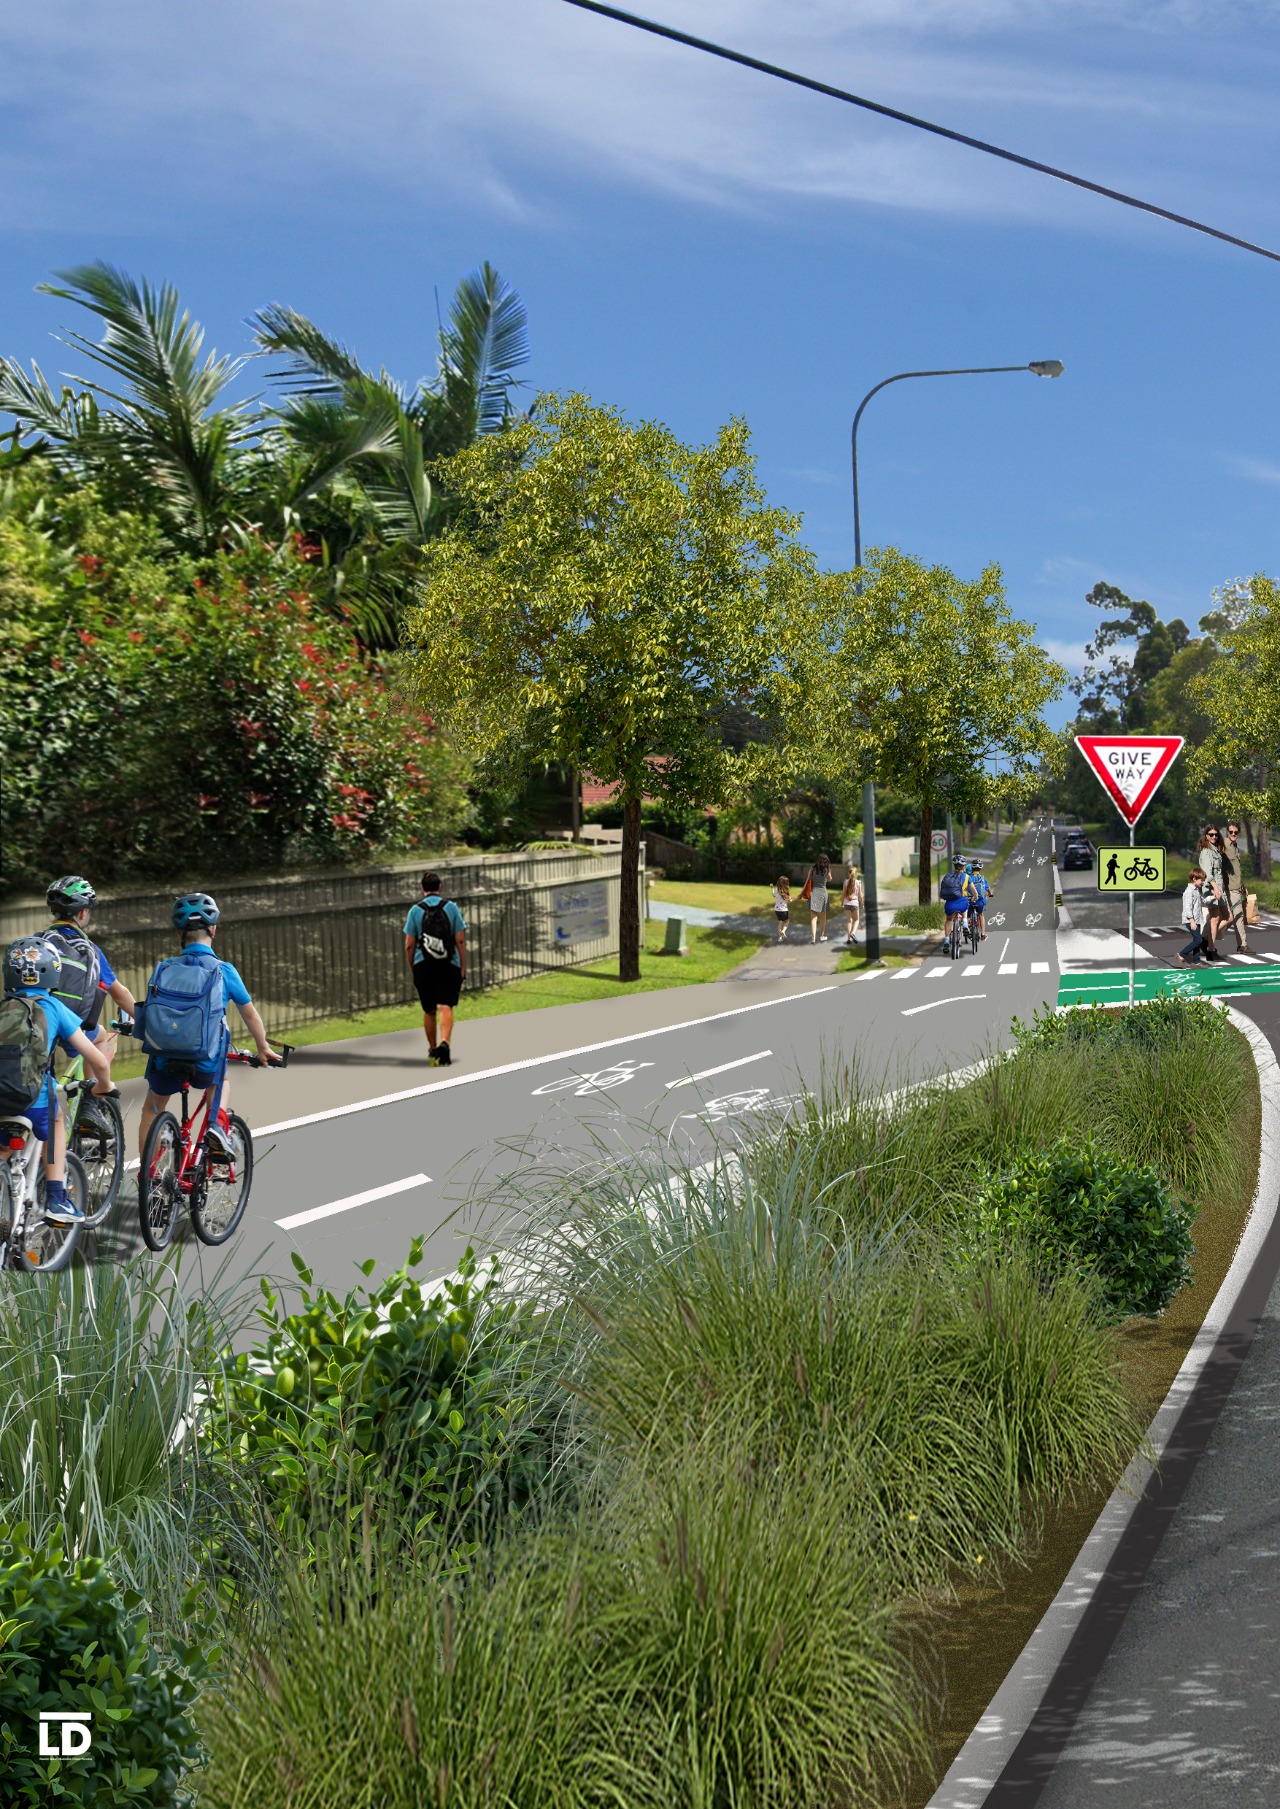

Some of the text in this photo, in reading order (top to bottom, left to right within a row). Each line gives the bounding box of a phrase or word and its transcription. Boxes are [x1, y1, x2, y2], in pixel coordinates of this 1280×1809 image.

[1108, 752, 1152, 765] GIVE
[1115, 767, 1145, 779] WAY
[933, 838, 945, 846] 60
